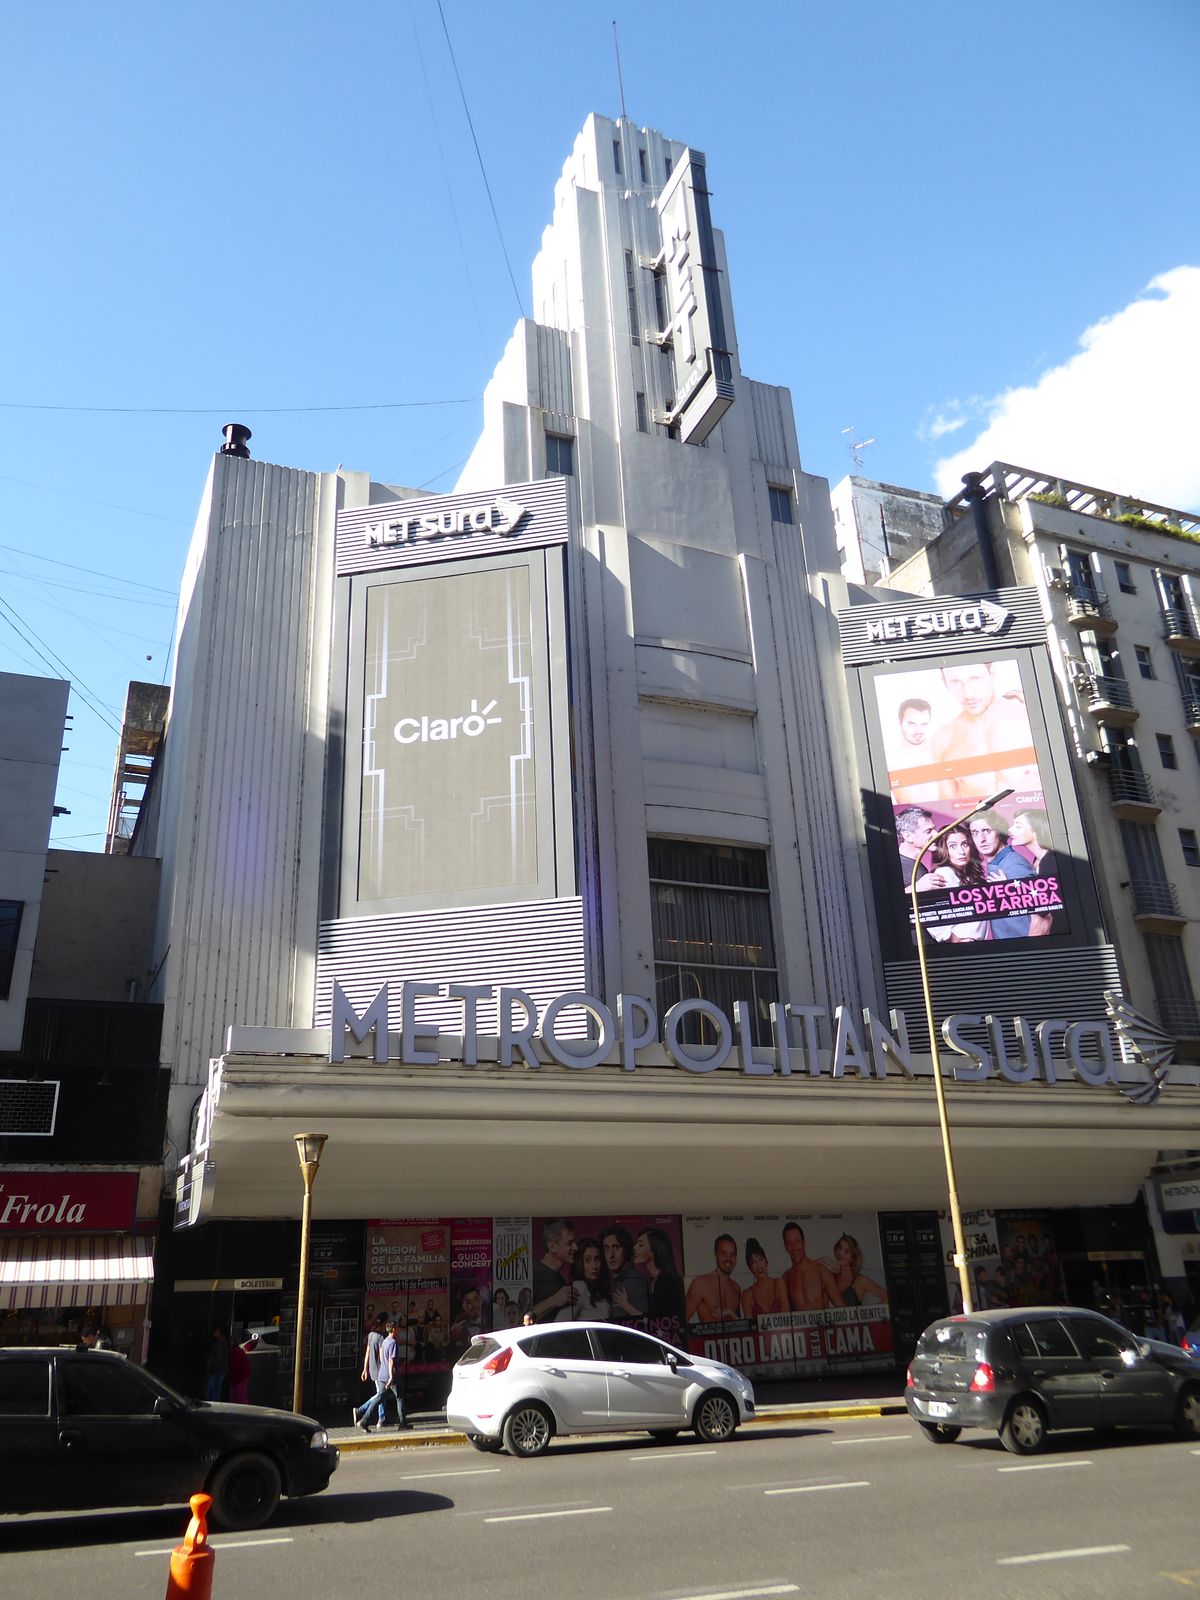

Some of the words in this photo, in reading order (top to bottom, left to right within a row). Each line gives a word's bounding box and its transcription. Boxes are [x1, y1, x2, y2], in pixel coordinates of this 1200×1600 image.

[662, 180, 698, 365] MET
[365, 518, 415, 547] MET
[419, 505, 493, 539] sura
[866, 616, 908, 642] MET
[914, 607, 983, 636] sura
[393, 714, 486, 744] Claro
[1015, 795, 1040, 804] Claro
[949, 889, 982, 906] LOS
[981, 877, 1059, 899] VECINOS
[974, 900, 997, 914] DE
[1000, 891, 1062, 911] ARRIBA
[329, 975, 916, 1081] METROPOLITAN
[941, 1013, 1119, 1087] sura
[0, 1194, 87, 1224] Frola
[372, 1237, 386, 1246] LA
[371, 1256, 386, 1265] DE
[388, 1255, 402, 1264] LA
[404, 1254, 446, 1264] FAMILIA
[451, 1259, 492, 1268] CONCERT
[457, 1253, 487, 1261] GUIDO
[371, 1264, 423, 1274] COLEMAN
[417, 1279, 440, 1289] Febrero
[773, 1315, 807, 1328] COMEDIA
[808, 1313, 823, 1324] QUE
[849, 1309, 859, 1321] LA
[811, 1329, 821, 1343] LA
[824, 1325, 876, 1355] CAMA
[703, 1336, 756, 1365] OTRO
[758, 1331, 808, 1362] LADO
[811, 1343, 822, 1357] DE
